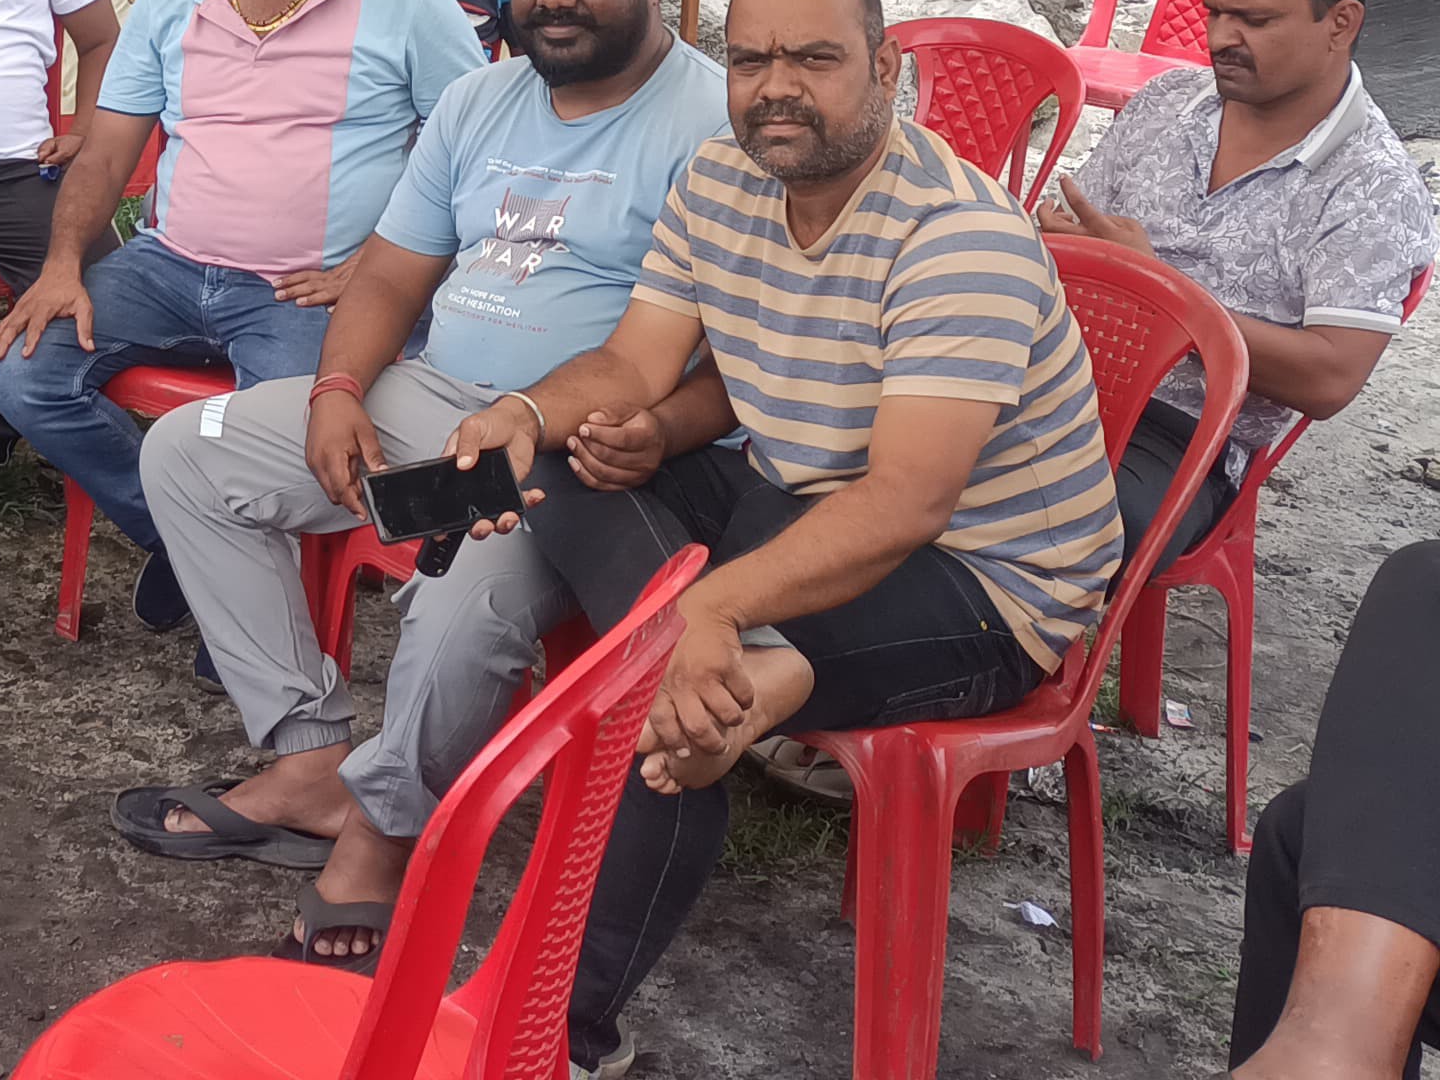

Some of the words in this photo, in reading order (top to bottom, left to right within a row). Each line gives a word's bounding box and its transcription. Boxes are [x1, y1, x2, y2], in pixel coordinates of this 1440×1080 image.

[495, 207, 564, 235] WAR
[479, 238, 542, 274] WAR
[467, 298, 521, 318] HESITATION
